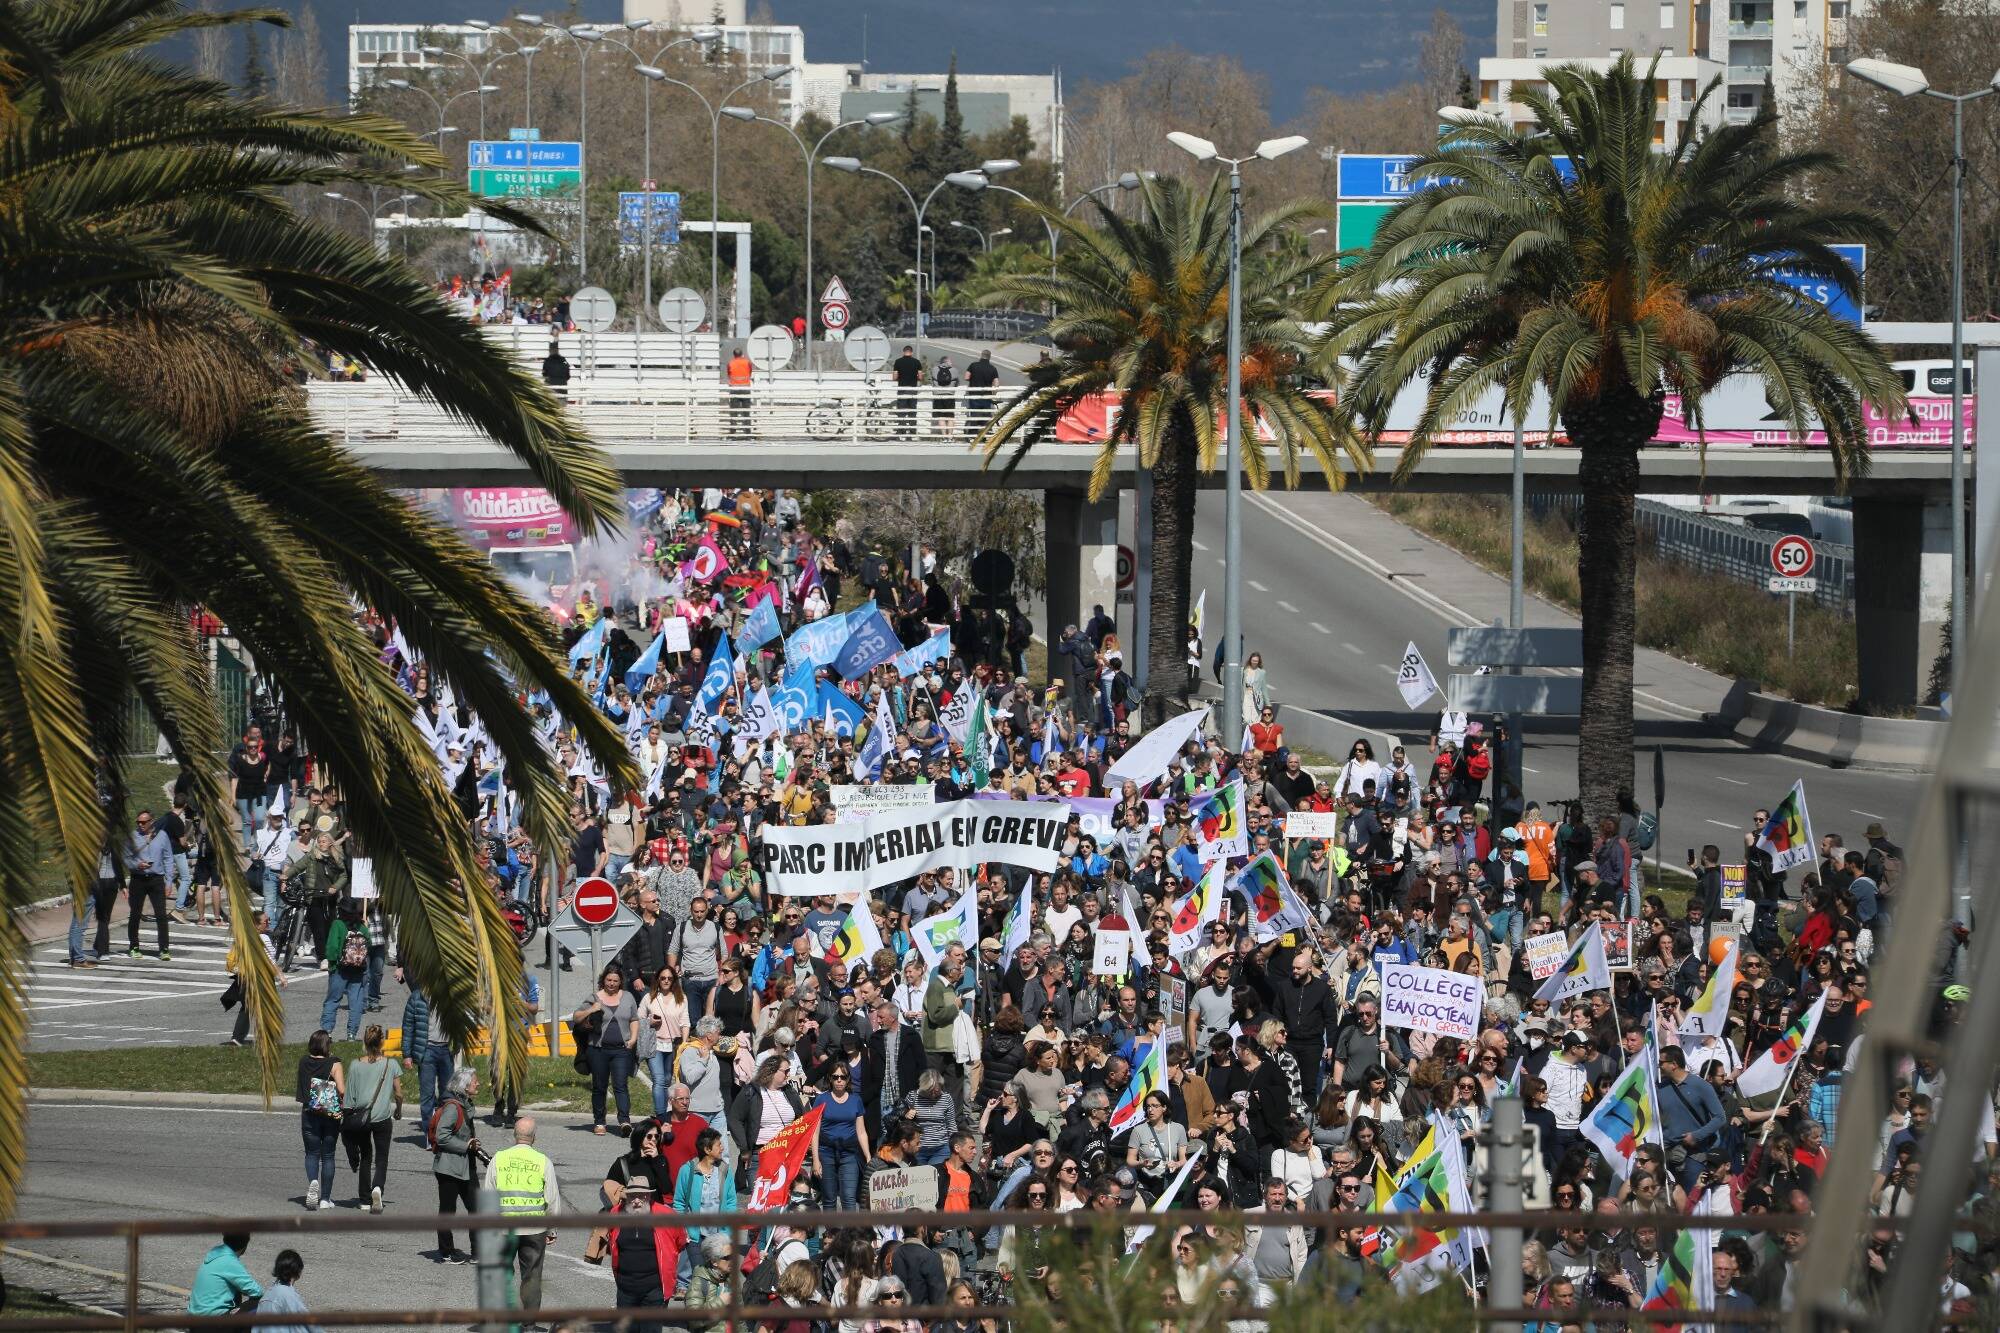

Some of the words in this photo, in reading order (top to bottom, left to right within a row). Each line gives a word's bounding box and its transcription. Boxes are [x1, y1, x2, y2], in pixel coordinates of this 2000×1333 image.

[829, 310, 844, 322] 30
[1931, 377, 1954, 385] GSF
[1480, 412, 1492, 424] m
[1897, 427, 1940, 444] avril
[1780, 548, 1806, 566] 50
[763, 842, 826, 875] PARC
[834, 819, 945, 873] IMPERIAL
[951, 816, 978, 847] EN
[1724, 867, 1745, 881] NON
[1104, 954, 1117, 967] 64
[1387, 972, 1476, 1003] COLLÈGE
[1417, 1003, 1474, 1026] COCTEAU
[1412, 1016, 1429, 1028] EN
